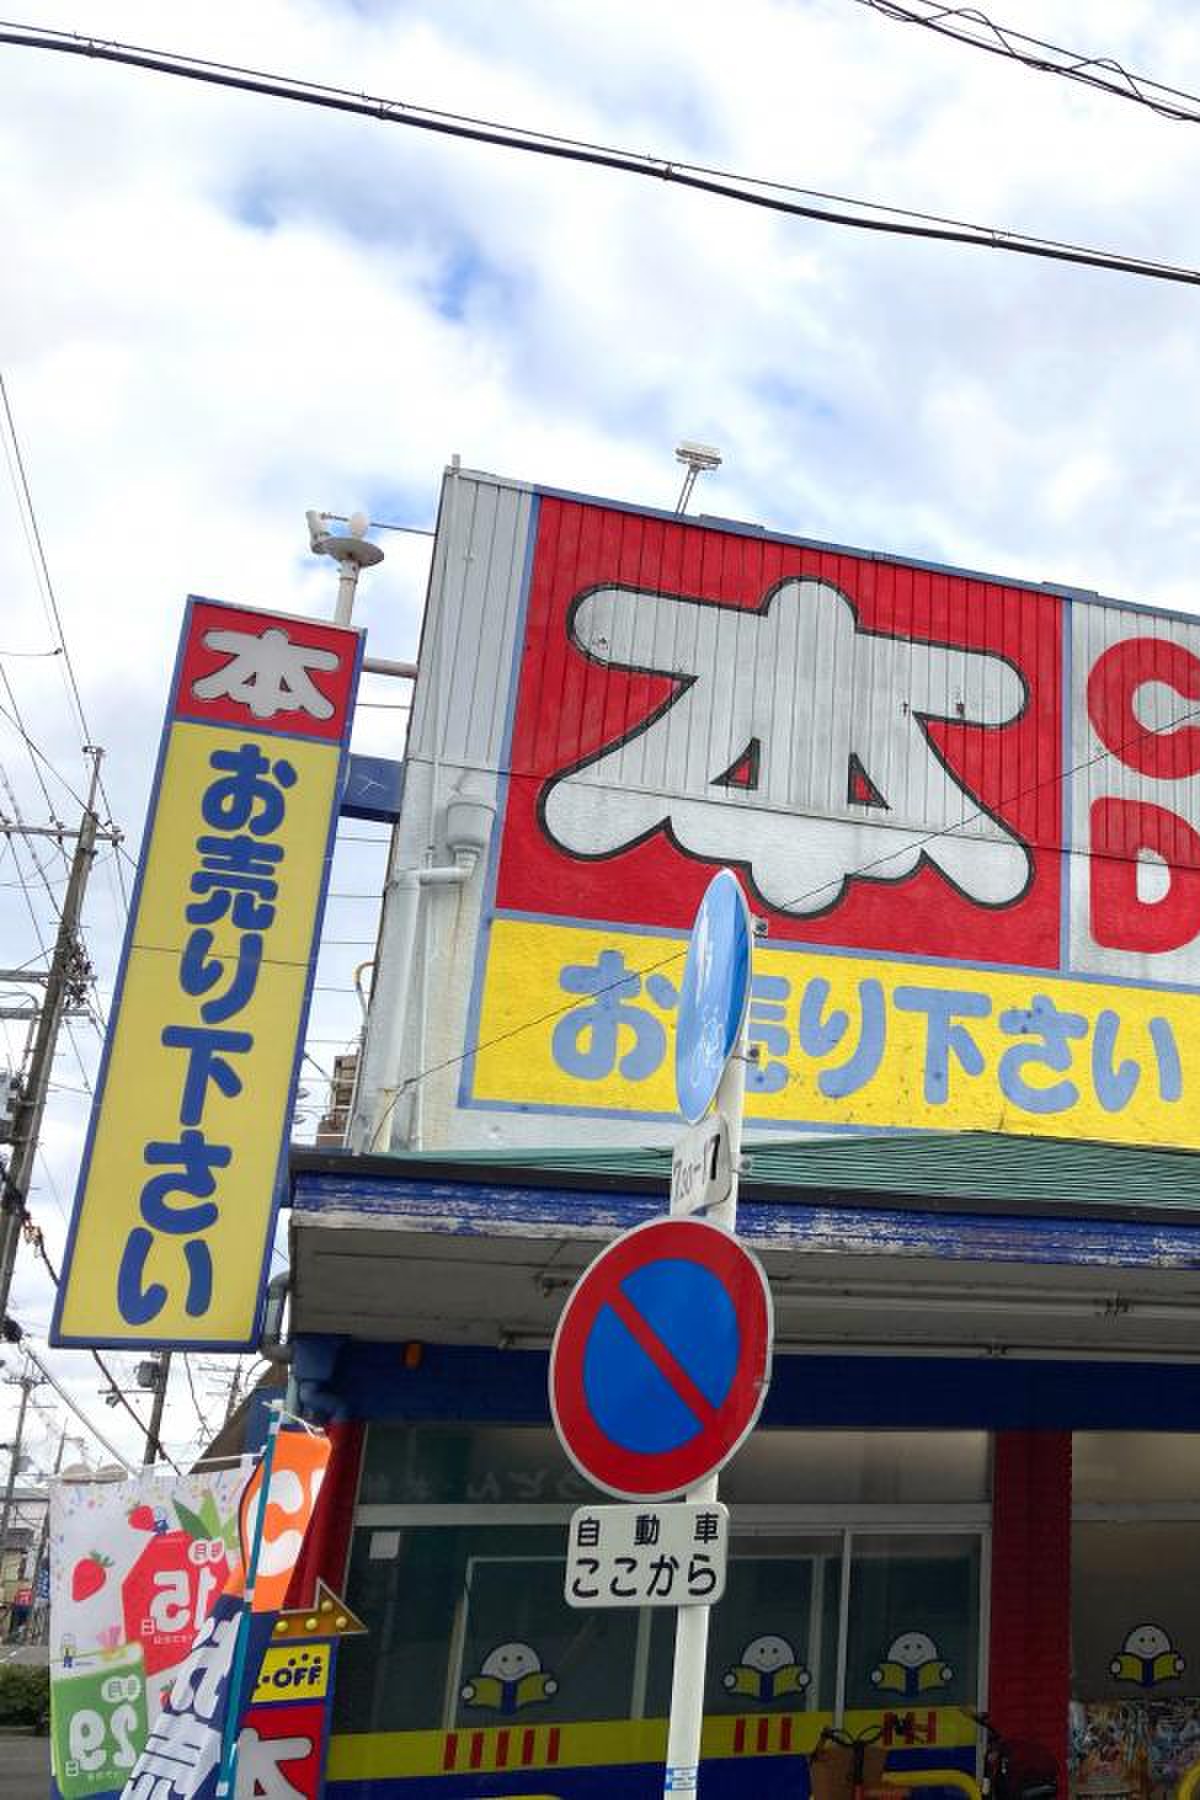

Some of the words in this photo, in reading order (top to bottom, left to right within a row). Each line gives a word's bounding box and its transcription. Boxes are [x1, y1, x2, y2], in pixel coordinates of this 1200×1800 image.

[191, 626, 342, 720] 本
[536, 574, 1036, 920] 本
[117, 743, 298, 1326] お売り下さい
[572, 1554, 717, 1598] ここから
[577, 1513, 719, 1547] 自動車
